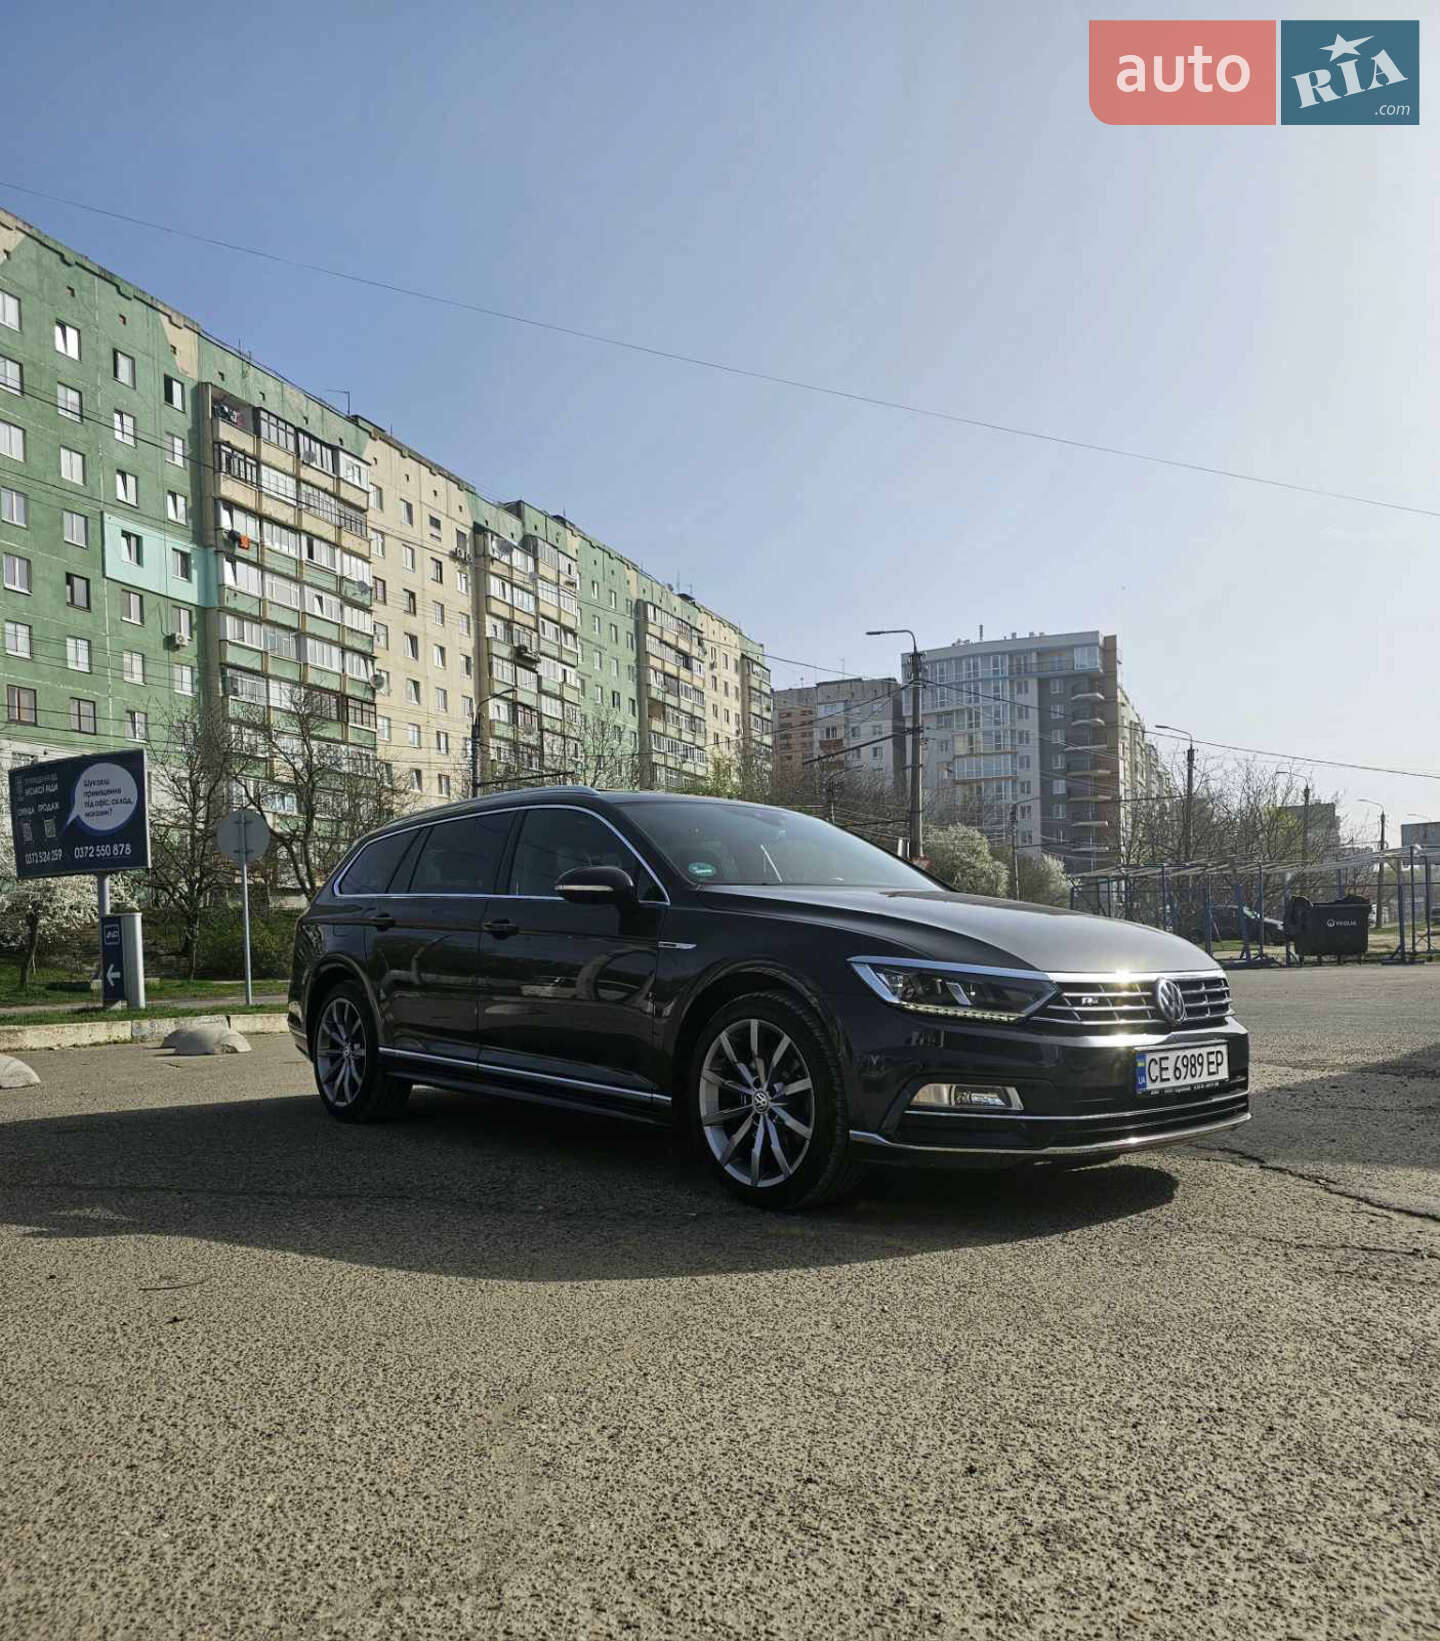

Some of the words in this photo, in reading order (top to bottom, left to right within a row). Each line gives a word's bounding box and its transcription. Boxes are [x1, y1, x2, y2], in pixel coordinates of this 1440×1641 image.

[74, 845, 95, 859] 0372
[112, 842, 132, 855] 878
[1148, 1056, 1171, 1084] CE
[1173, 1053, 1205, 1081] 6989
[1206, 1050, 1224, 1076] EP
